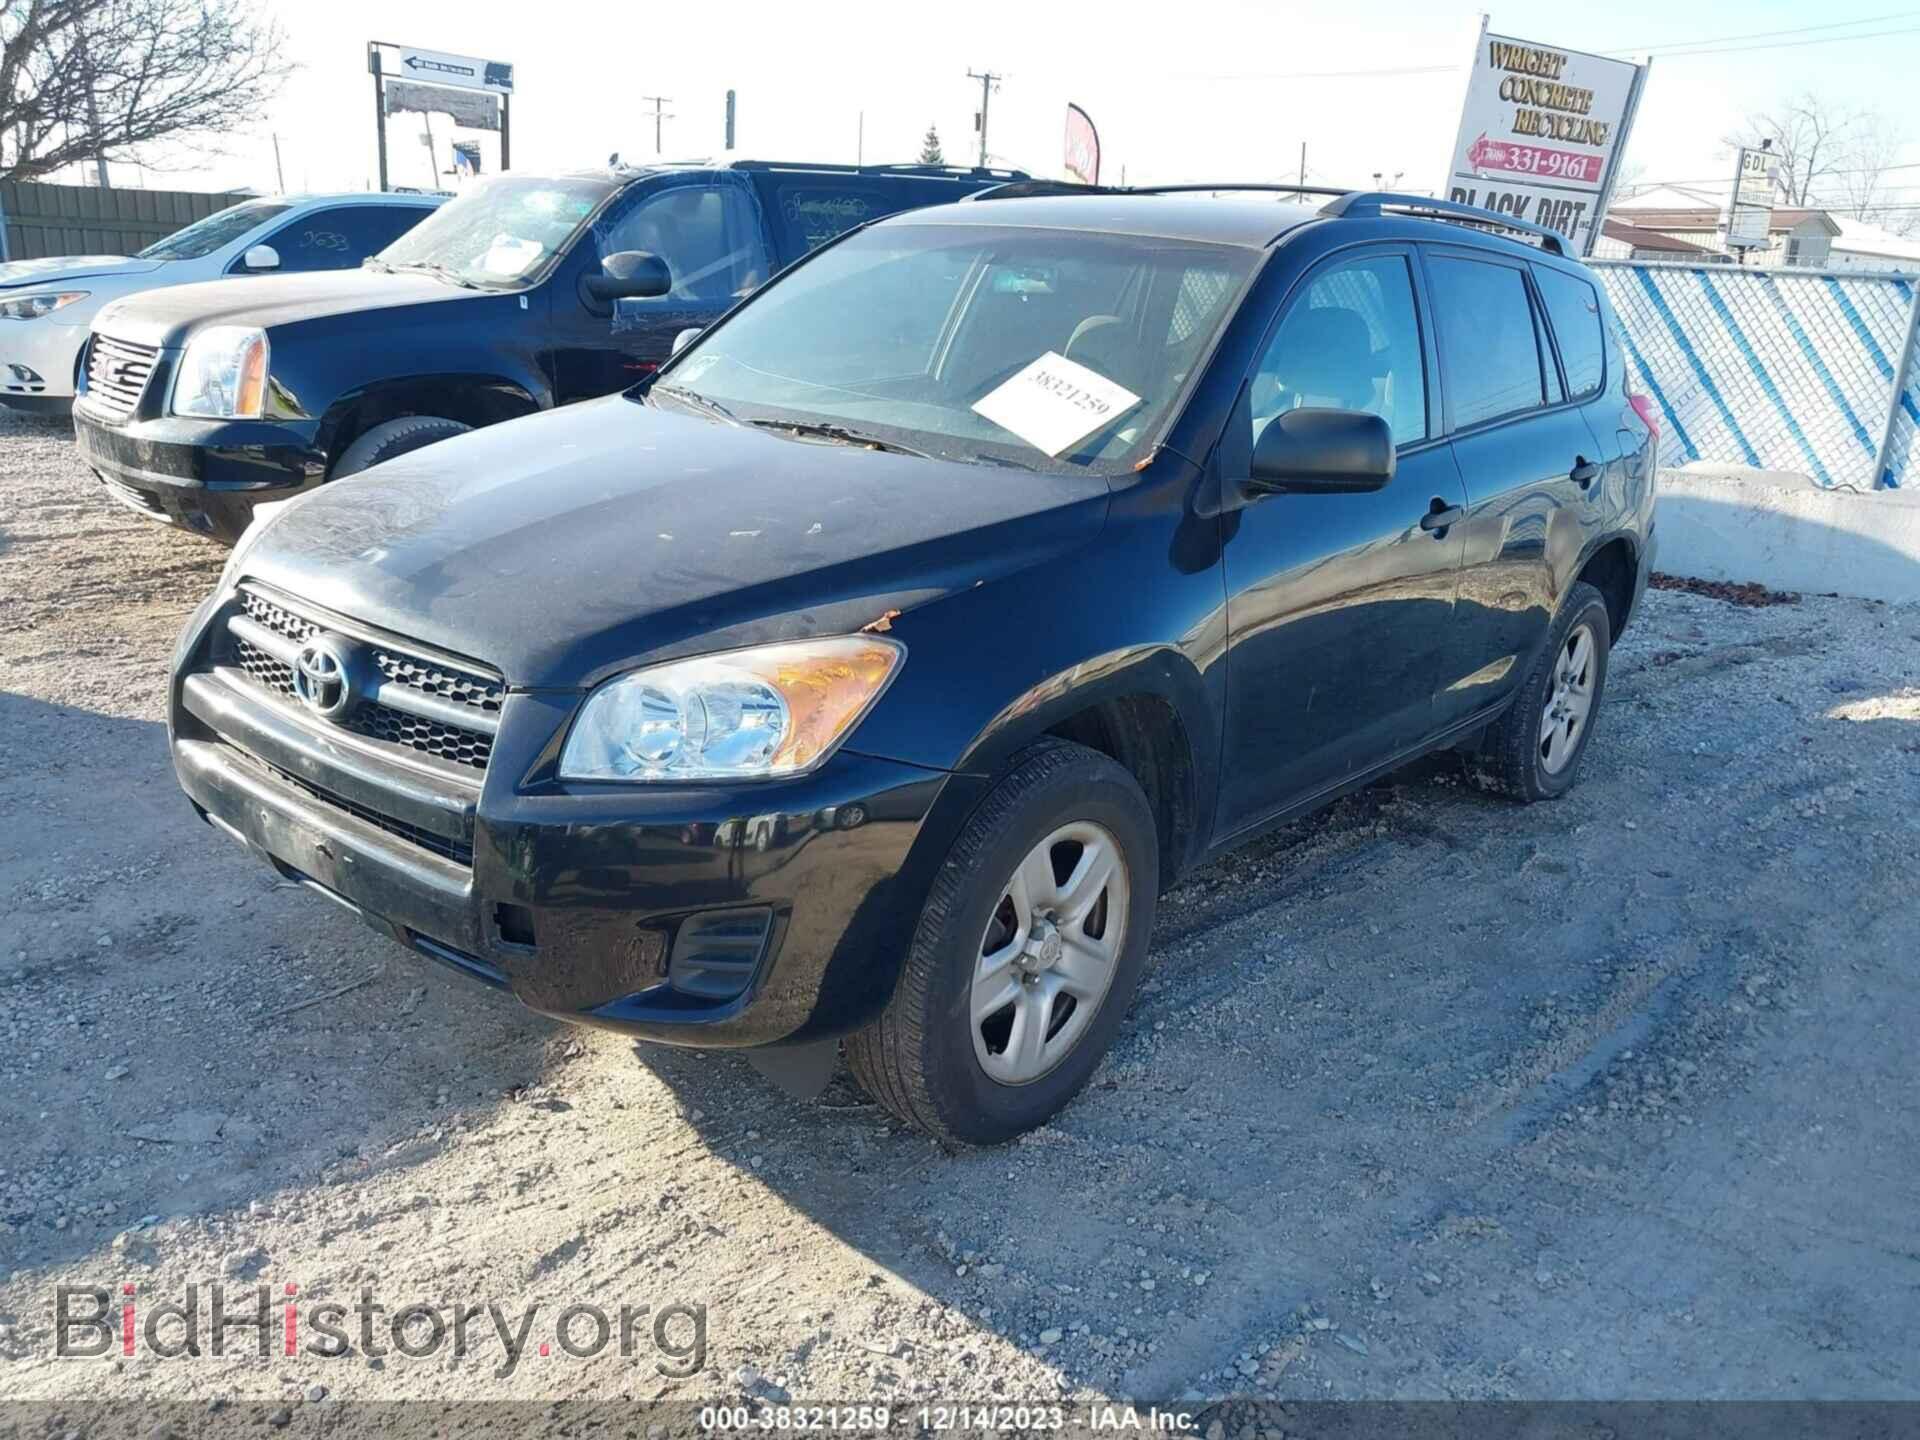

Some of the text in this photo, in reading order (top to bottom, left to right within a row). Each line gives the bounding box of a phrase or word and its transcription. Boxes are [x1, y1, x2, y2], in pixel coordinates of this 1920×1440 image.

[1489, 41, 1567, 80] WRIGHT
[1499, 75, 1594, 115] CONCRETE
[1512, 108, 1610, 147] RECYCLING
[1504, 147, 1589, 179] 331-9161
[1535, 198, 1587, 240] DIRT
